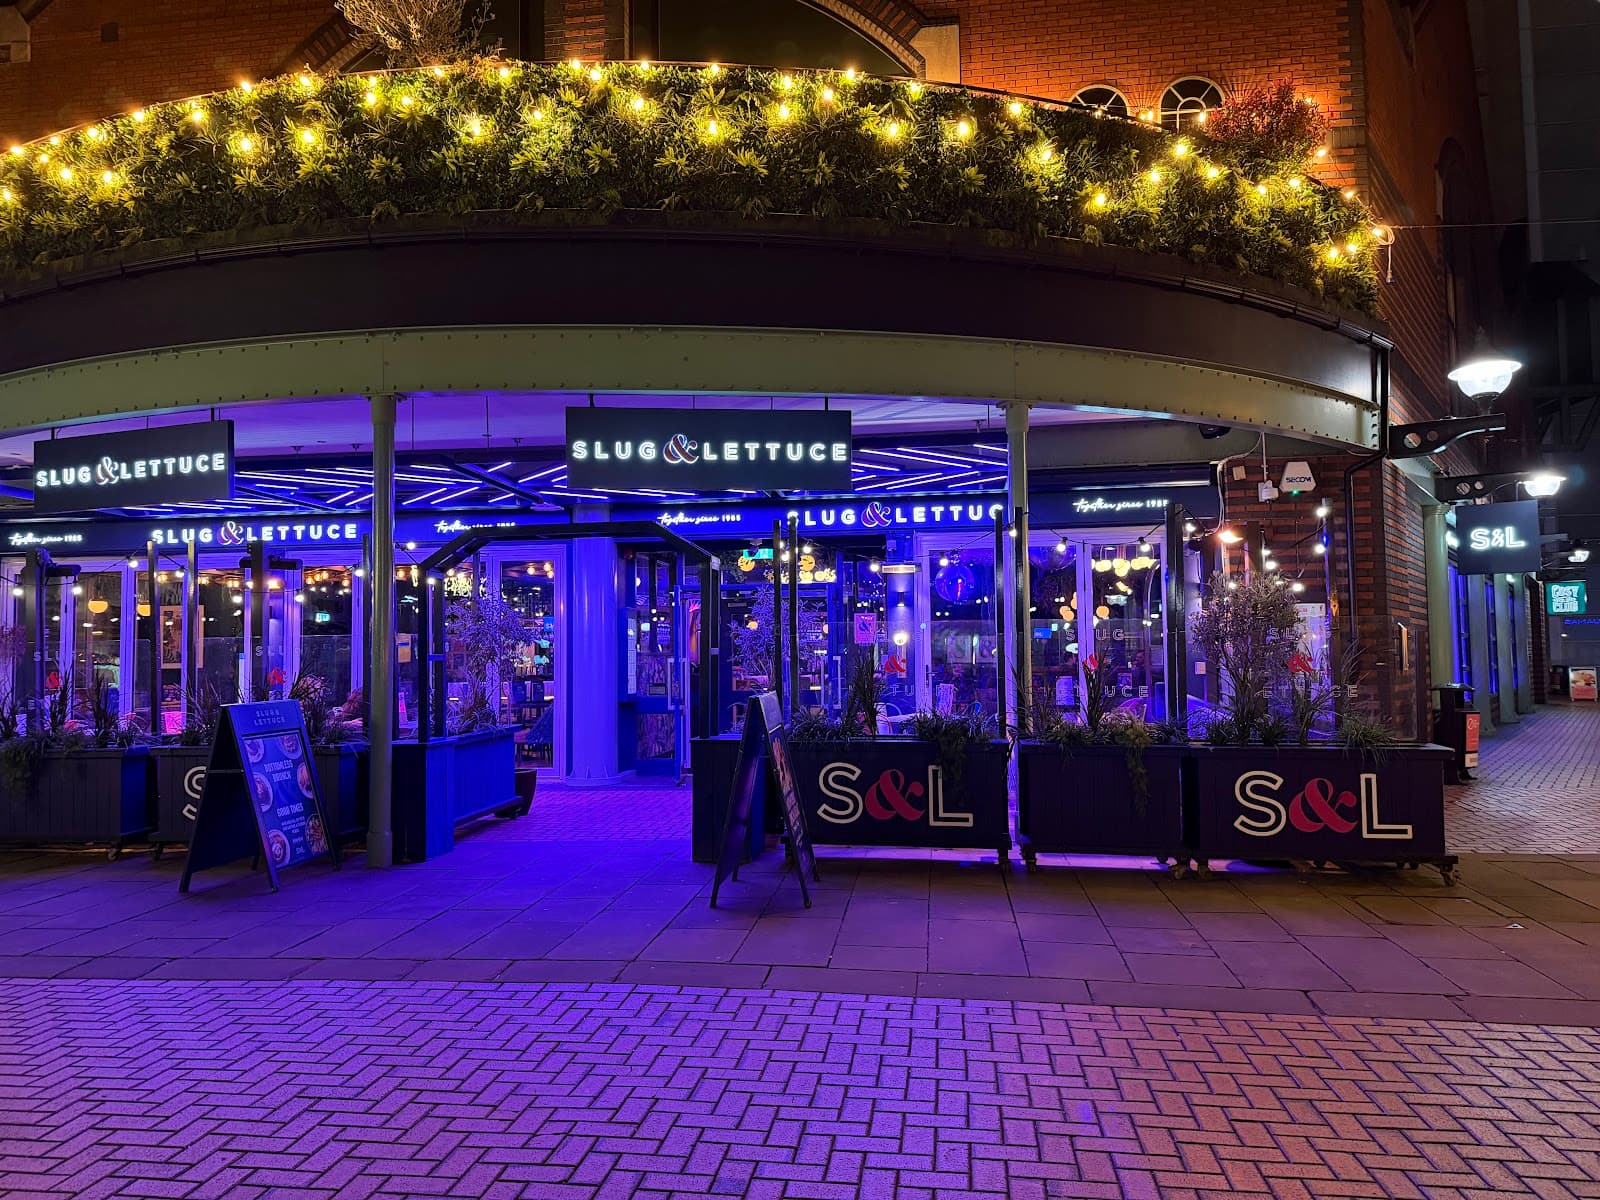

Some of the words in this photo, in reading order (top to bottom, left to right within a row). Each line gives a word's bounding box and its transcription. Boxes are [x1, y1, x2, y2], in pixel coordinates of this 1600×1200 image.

[573, 440, 657, 460] SLUG
[663, 433, 700, 464] &
[703, 441, 848, 461] LETTUCE
[36, 466, 92, 487] SLUG
[95, 456, 120, 486] &
[120, 453, 226, 479] LETTUCE
[1285, 476, 1312, 484] SECOM
[861, 501, 893, 527] &
[896, 504, 1004, 524] LETTUC
[151, 528, 213, 544] SLUG
[216, 520, 244, 545] &
[246, 523, 358, 542] LETTUCE
[1470, 525, 1527, 550] S&L
[1065, 628, 1125, 641] SUG
[817, 761, 974, 828] S&L
[1233, 769, 1414, 839] S&L
